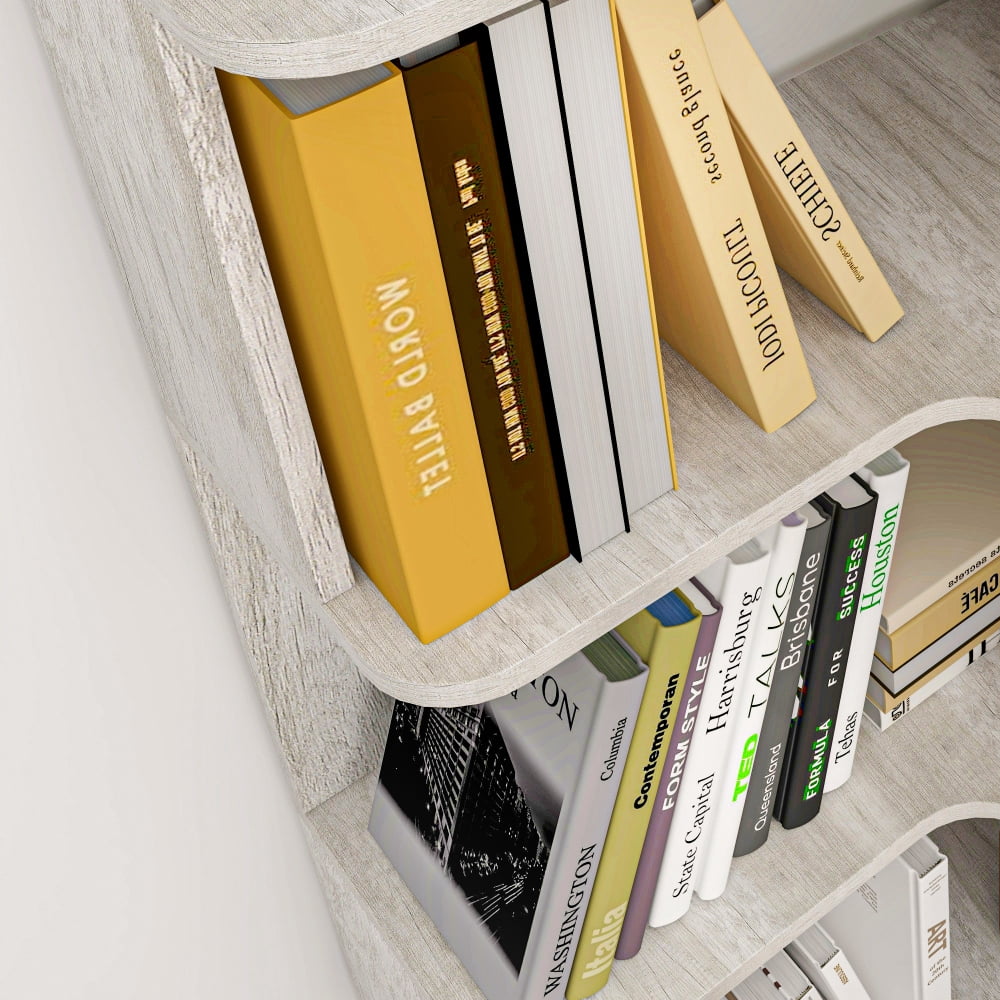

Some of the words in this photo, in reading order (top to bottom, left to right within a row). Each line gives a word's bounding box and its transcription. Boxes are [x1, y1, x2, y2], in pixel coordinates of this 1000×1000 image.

[860, 503, 900, 616] Houston
[781, 552, 821, 672] Brisbane
[706, 586, 763, 736] Harrisburg
[806, 718, 832, 801] FORMULA
[828, 648, 842, 688] FOR
[839, 534, 866, 621] SUCCESS
[601, 716, 628, 782] Columbia
[662, 739, 689, 812] FORM
[681, 652, 711, 734] STYLE
[732, 733, 759, 802] TED
[835, 710, 858, 765] Tehas
[685, 773, 715, 849] Capital
[754, 742, 782, 832] Queensland
[673, 847, 698, 898] State
[544, 842, 598, 998] WASHINGTON
[582, 901, 627, 981] Italia
[927, 919, 947, 959] ART
